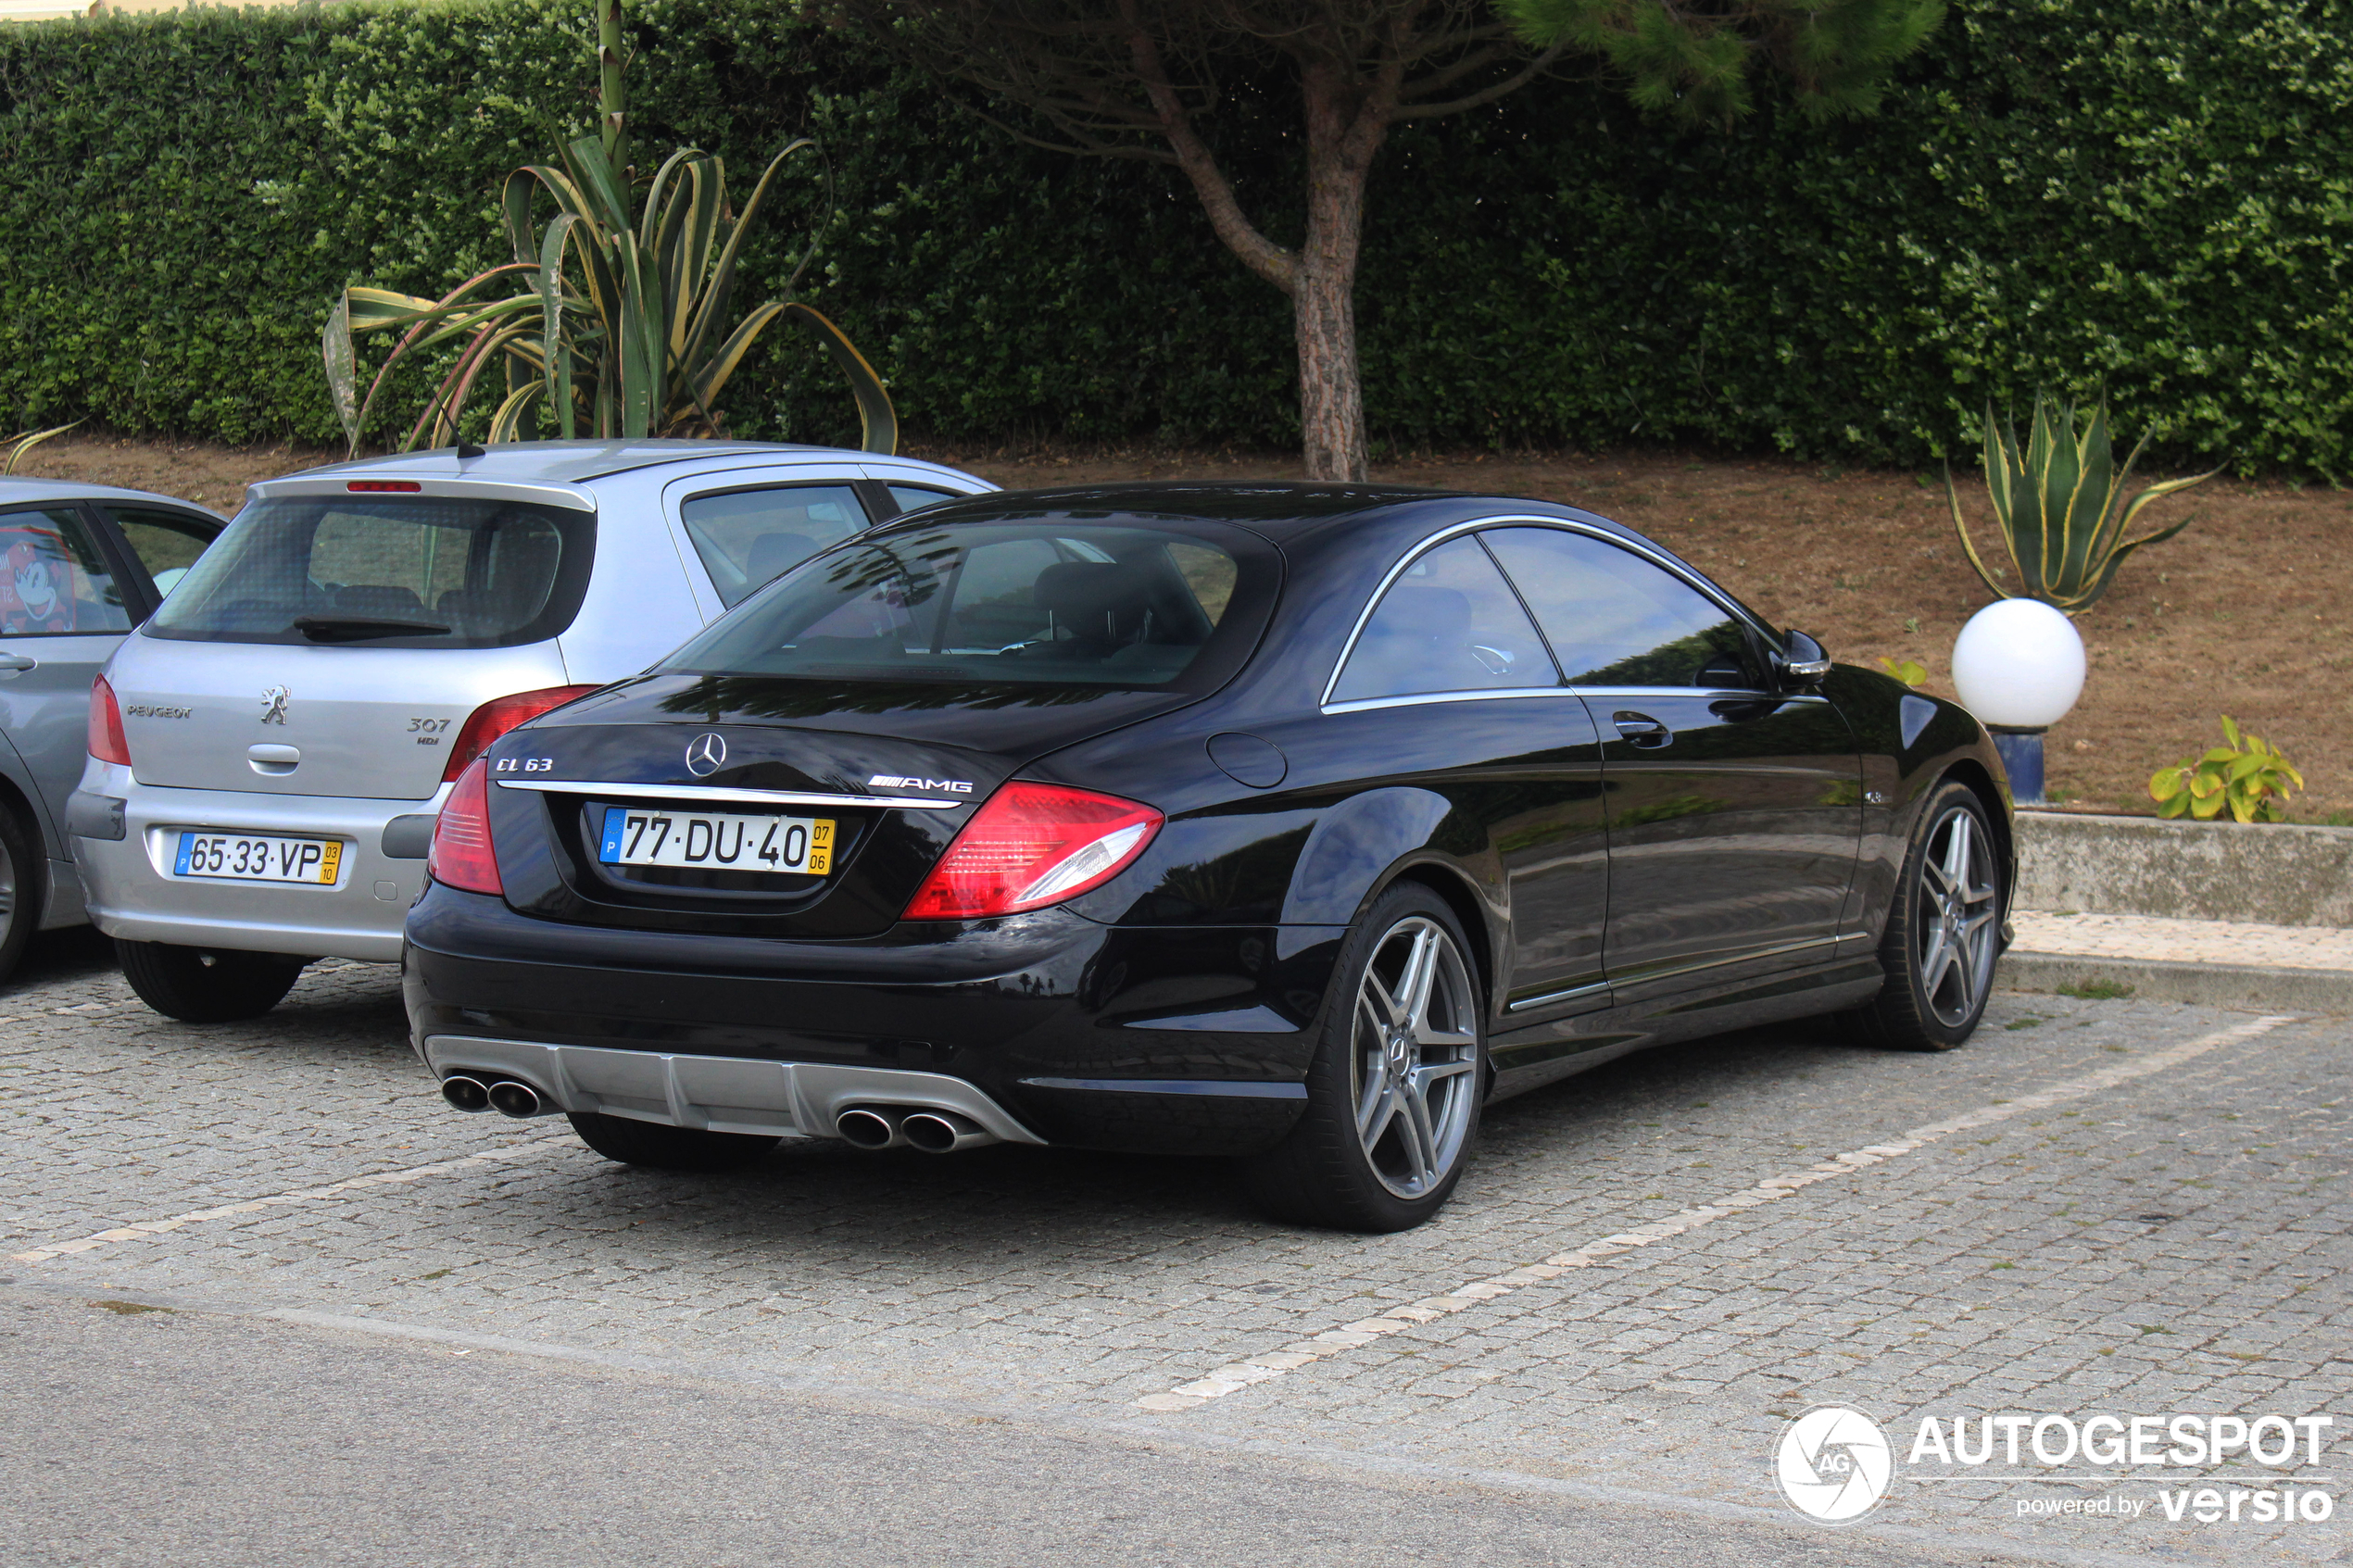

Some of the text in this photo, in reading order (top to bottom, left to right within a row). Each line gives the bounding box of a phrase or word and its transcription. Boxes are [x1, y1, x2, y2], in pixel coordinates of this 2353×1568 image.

[128, 705, 192, 719] PEUGEOT
[407, 717, 451, 733] 307
[497, 759, 553, 771] CL 63
[900, 777, 973, 793] AMG
[813, 825, 830, 840] 07
[325, 847, 337, 859] 03
[607, 842, 616, 852] P
[180, 859, 187, 867] P
[810, 855, 825, 870] 06
[323, 869, 333, 880] 10
